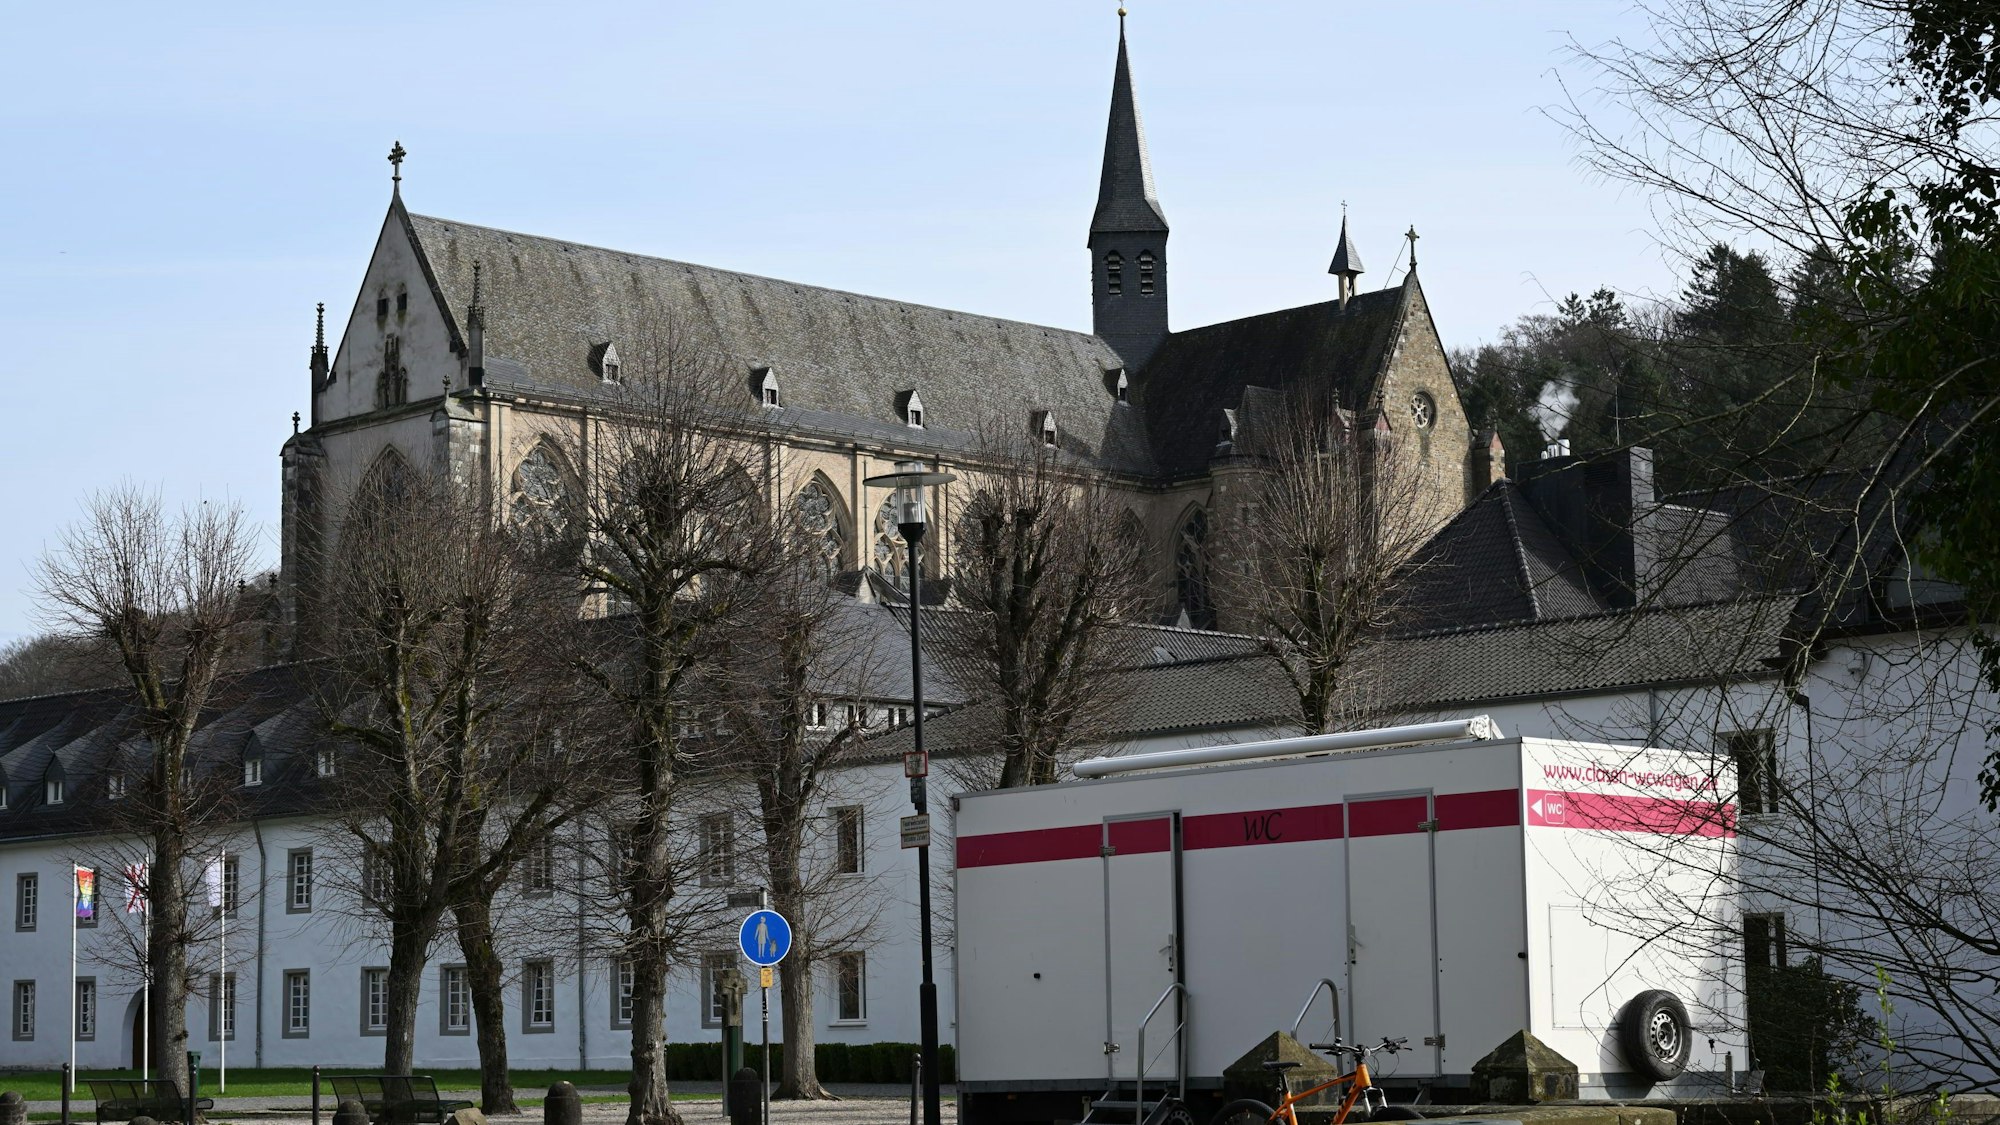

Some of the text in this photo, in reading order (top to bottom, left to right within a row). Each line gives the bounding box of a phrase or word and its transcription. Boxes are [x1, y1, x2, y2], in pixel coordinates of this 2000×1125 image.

[1544, 761, 1718, 791] www.clasen-wcwagende
[1547, 802, 1563, 815] WC
[1243, 812, 1282, 842] WC
